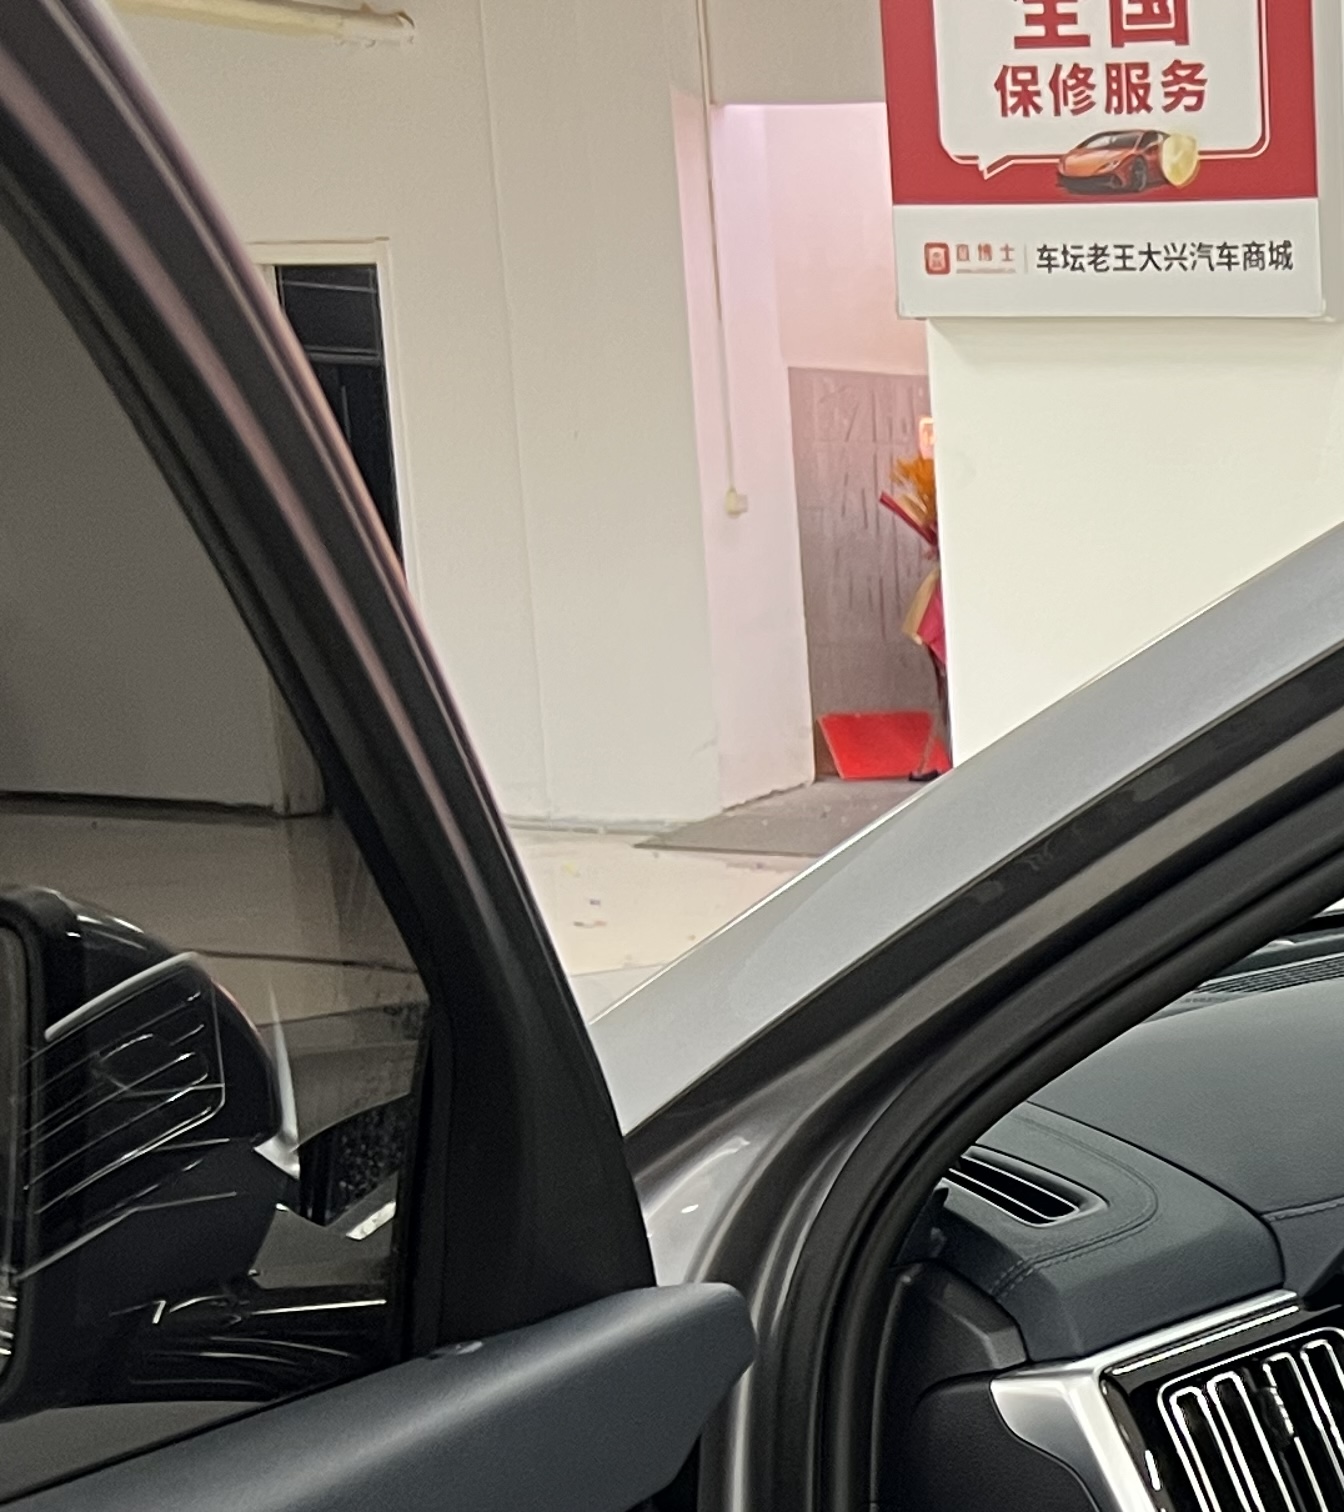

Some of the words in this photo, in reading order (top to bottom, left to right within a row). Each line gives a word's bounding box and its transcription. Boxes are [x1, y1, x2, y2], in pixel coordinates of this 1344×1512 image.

[994, 60, 1208, 117] 保修服务
[1036, 240, 1294, 274] 车坛老王大兴汽车商城
